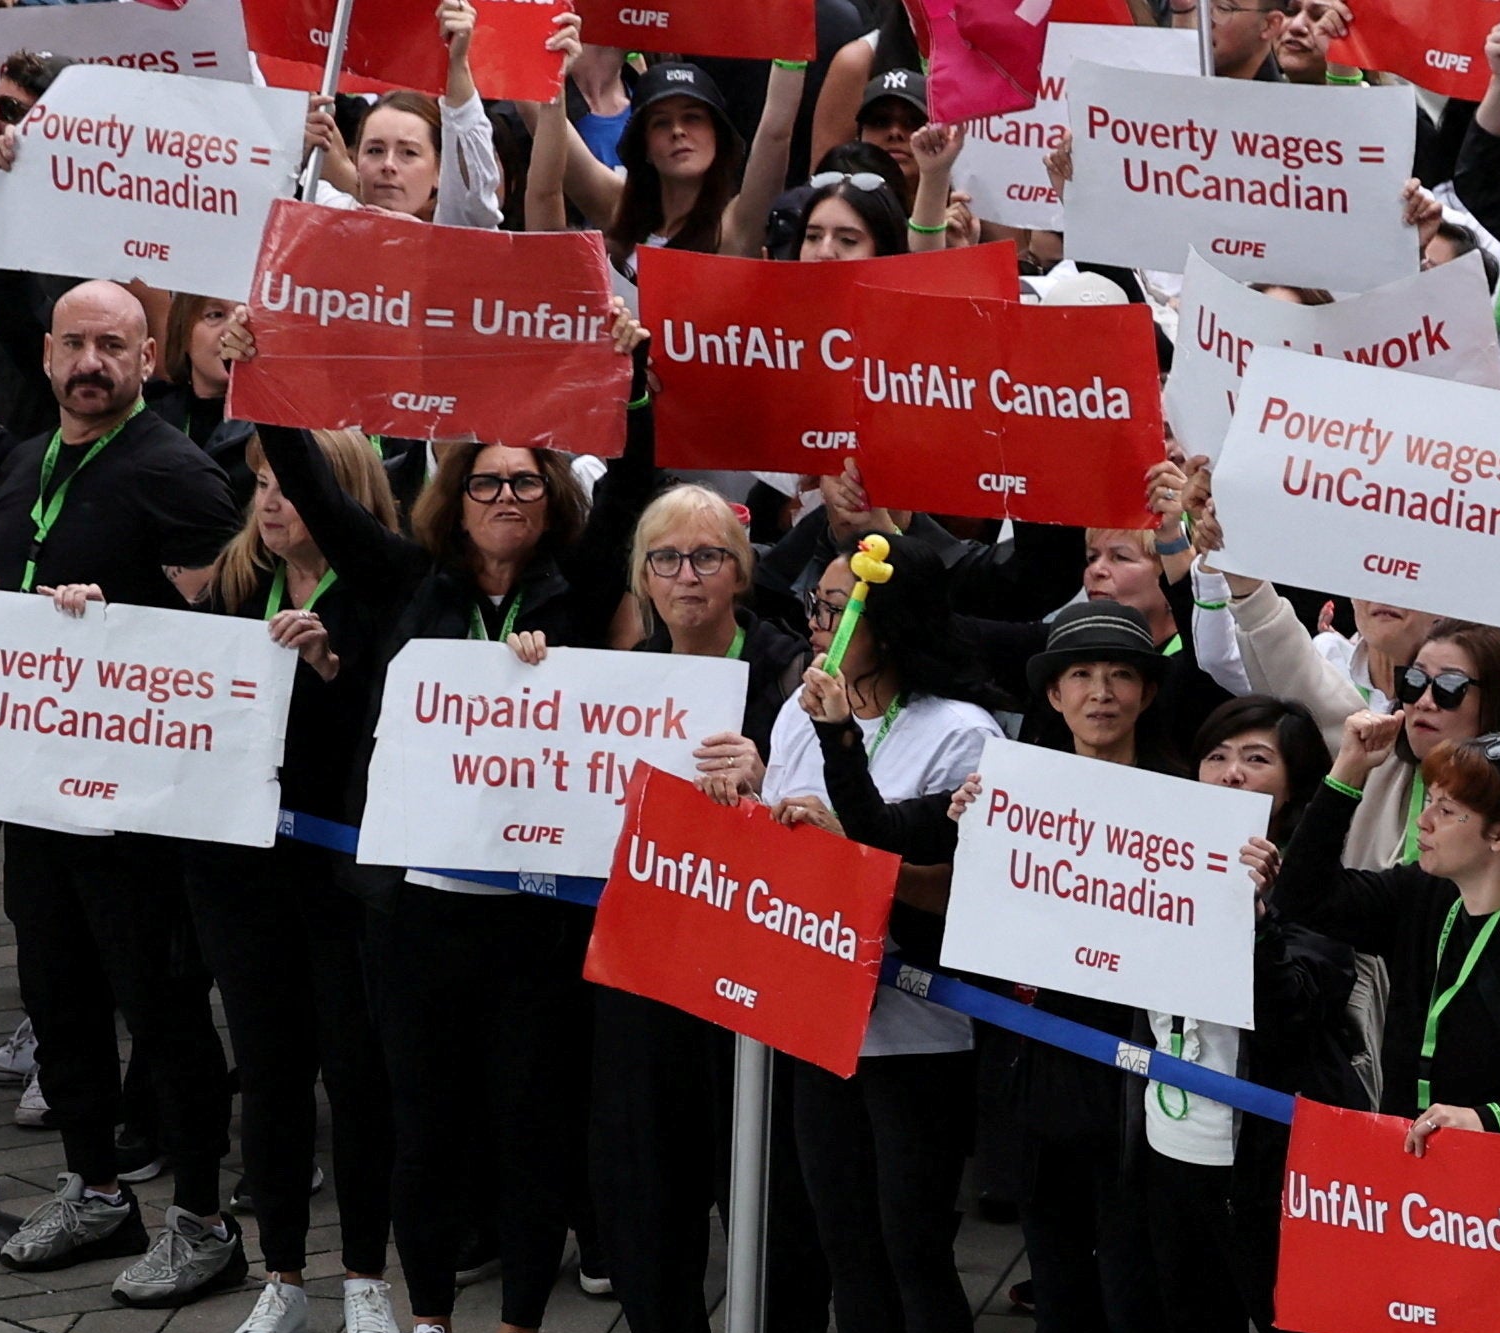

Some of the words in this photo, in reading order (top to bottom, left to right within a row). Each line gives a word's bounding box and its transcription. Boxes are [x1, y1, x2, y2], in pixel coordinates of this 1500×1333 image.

[619, 9, 669, 29] CUPE
[1426, 50, 1471, 73] CUPE
[23, 104, 135, 158] Poverty
[146, 123, 238, 170] wages
[251, 146, 271, 167] =
[1088, 106, 1219, 160] Poverty
[1232, 131, 1343, 169] wages
[1359, 144, 1384, 164] =
[51, 156, 238, 217] UnCanadian
[1006, 184, 1059, 203] CUPE
[1123, 158, 1349, 214] UnCanadian
[124, 240, 170, 262] CUPE
[1211, 238, 1266, 259] CUPE
[261, 272, 410, 328] Unpaid
[426, 308, 454, 329] =
[472, 299, 605, 343] Unfair
[663, 319, 804, 370] UnfAir
[391, 392, 457, 414] CUPE
[862, 356, 976, 411] UnfAir
[988, 368, 1131, 420] Canada
[1258, 396, 1394, 466] Poverty
[978, 472, 1027, 495] CUPE
[1363, 553, 1421, 581] CUPE
[96, 659, 215, 703] wages
[231, 678, 257, 700] =
[415, 682, 562, 736] Unpaid
[580, 696, 690, 740] work
[452, 747, 570, 793] won't
[58, 777, 118, 800] CUPE
[502, 824, 565, 845] CUPE
[986, 788, 1096, 858] Poverty
[1105, 822, 1195, 873] wages
[1206, 851, 1229, 873] =
[518, 876, 557, 898] YVR
[628, 835, 739, 913] UnfAir
[745, 879, 858, 963] Canada
[1009, 848, 1196, 927] UnCanadian
[1074, 946, 1122, 973] CUPE
[715, 977, 758, 1009] CUPE
[896, 973, 932, 998] YVR
[1115, 1051, 1151, 1076] YVR
[1288, 1170, 1389, 1235] UnfAir
[1388, 1302, 1437, 1327] CUPE
